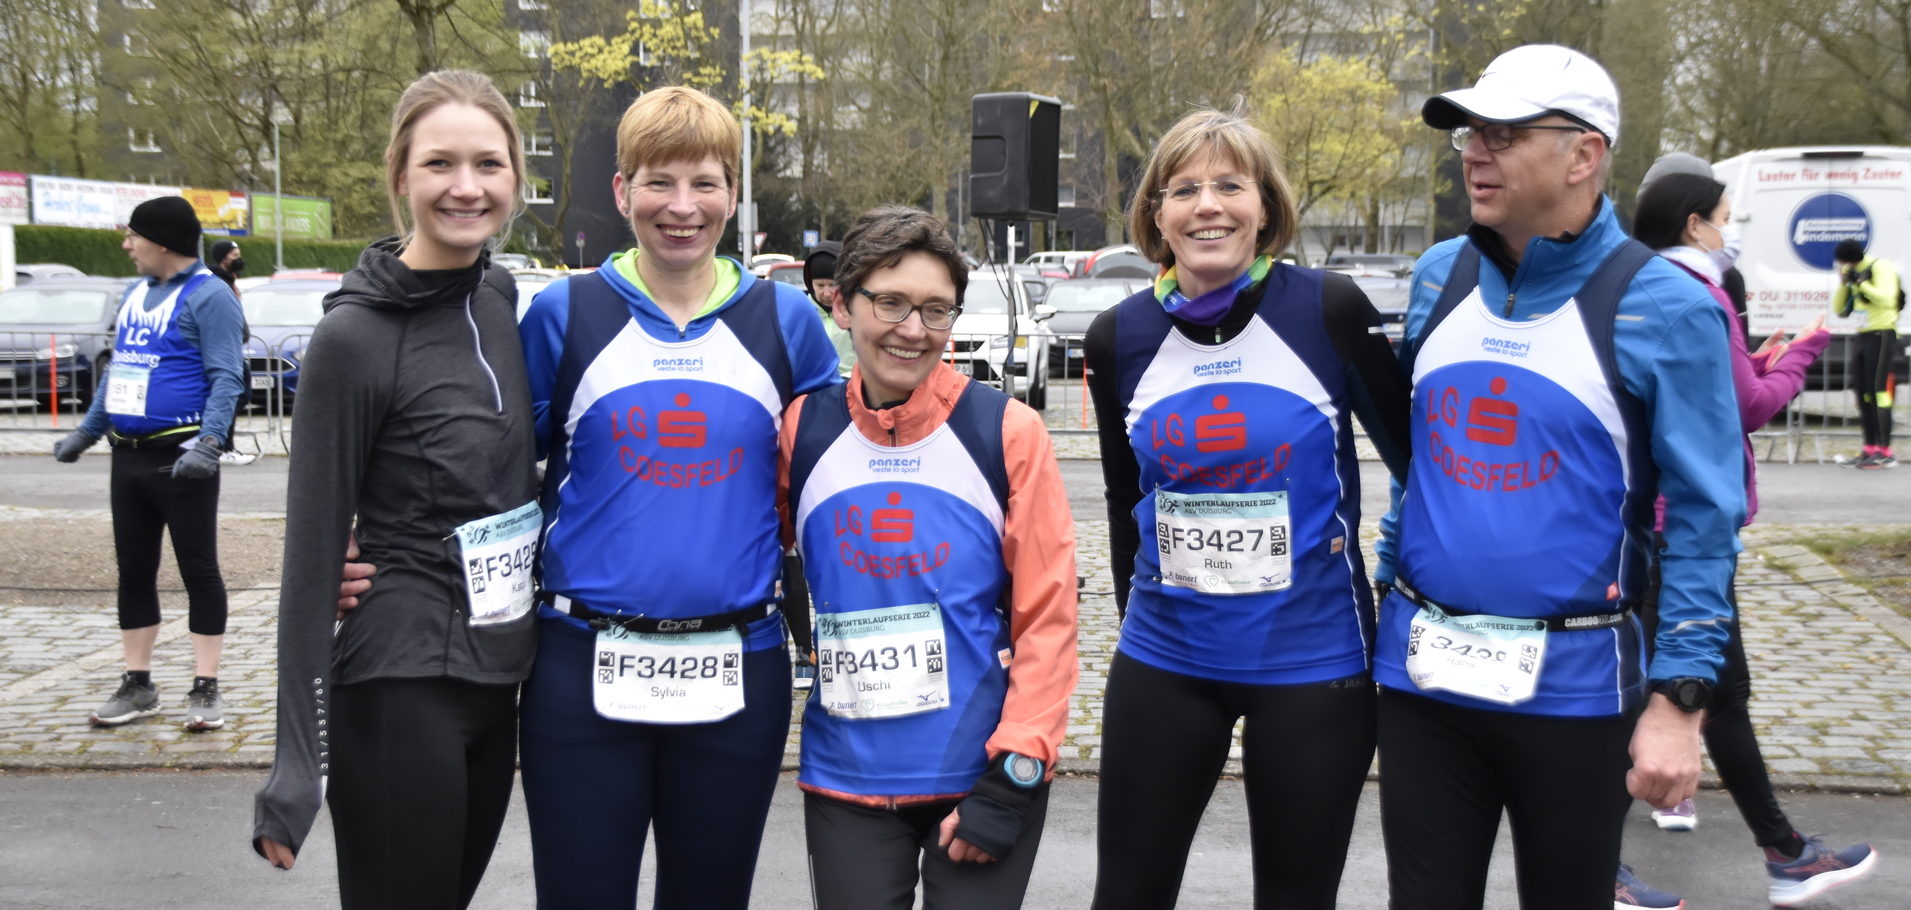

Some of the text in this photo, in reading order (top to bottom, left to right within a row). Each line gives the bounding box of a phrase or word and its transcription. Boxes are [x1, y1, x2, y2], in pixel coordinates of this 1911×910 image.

[1758, 168, 1903, 183] Laster für wenig Zaster
[1759, 291, 1778, 301] DU
[124, 326, 151, 346] LC
[1482, 336, 1531, 352] panzeri
[1484, 345, 1501, 354] veste
[1509, 349, 1528, 359] sport
[653, 357, 704, 368] panzeri
[1193, 356, 1242, 375] panzeri
[1196, 369, 1215, 378] veste
[1223, 366, 1242, 376] sport
[1426, 386, 1460, 429] LG
[612, 405, 647, 442] LG
[1152, 412, 1185, 451] LG
[619, 445, 744, 489] COESFELD
[869, 456, 922, 469] panzeri
[901, 466, 920, 474] sport
[1160, 442, 1292, 489] COESFELD
[1430, 430, 1560, 492] COESFELD
[1183, 498, 1277, 508] WINTERLAUFSERIE 2022
[835, 504, 863, 539] LG
[1171, 527, 1264, 553] F3427
[840, 541, 951, 579] COESFELD
[1204, 558, 1233, 570] Ruth
[836, 610, 931, 628] WINTERLAUFSERIE 2022
[618, 654, 719, 680] F3428
[835, 644, 918, 675] F3431
[650, 686, 686, 700] Sylvia
[857, 679, 892, 693] Uschi
